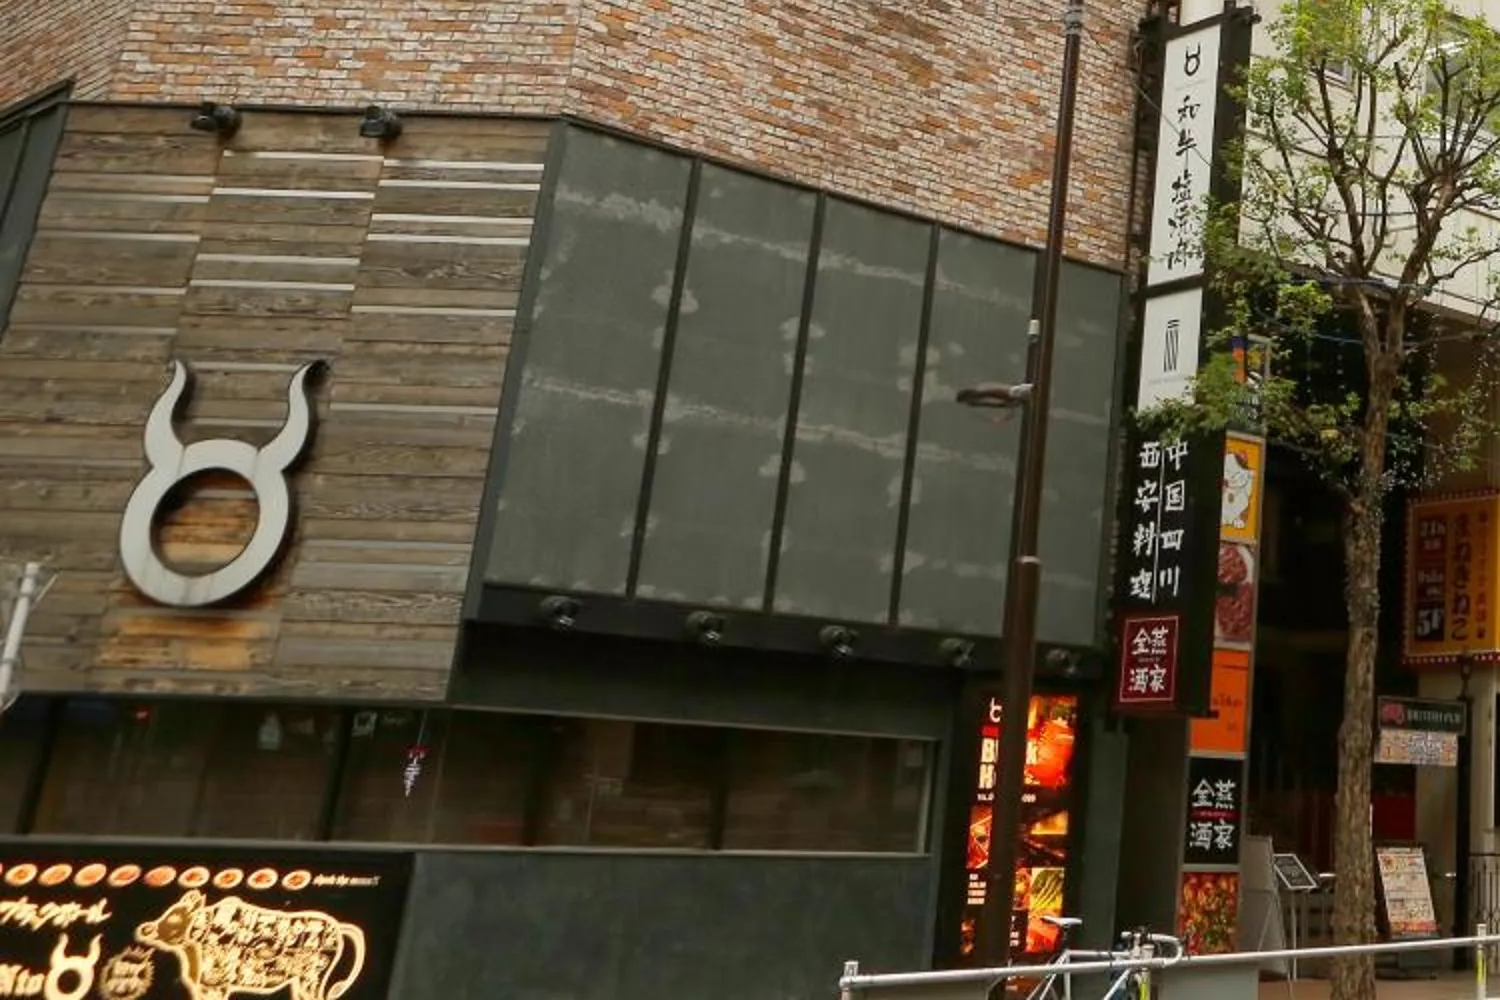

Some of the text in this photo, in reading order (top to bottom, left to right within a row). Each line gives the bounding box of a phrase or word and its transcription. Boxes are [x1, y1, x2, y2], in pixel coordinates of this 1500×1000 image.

[1130, 440, 1161, 600] 西安料理
[1159, 437, 1189, 598] 中国四川
